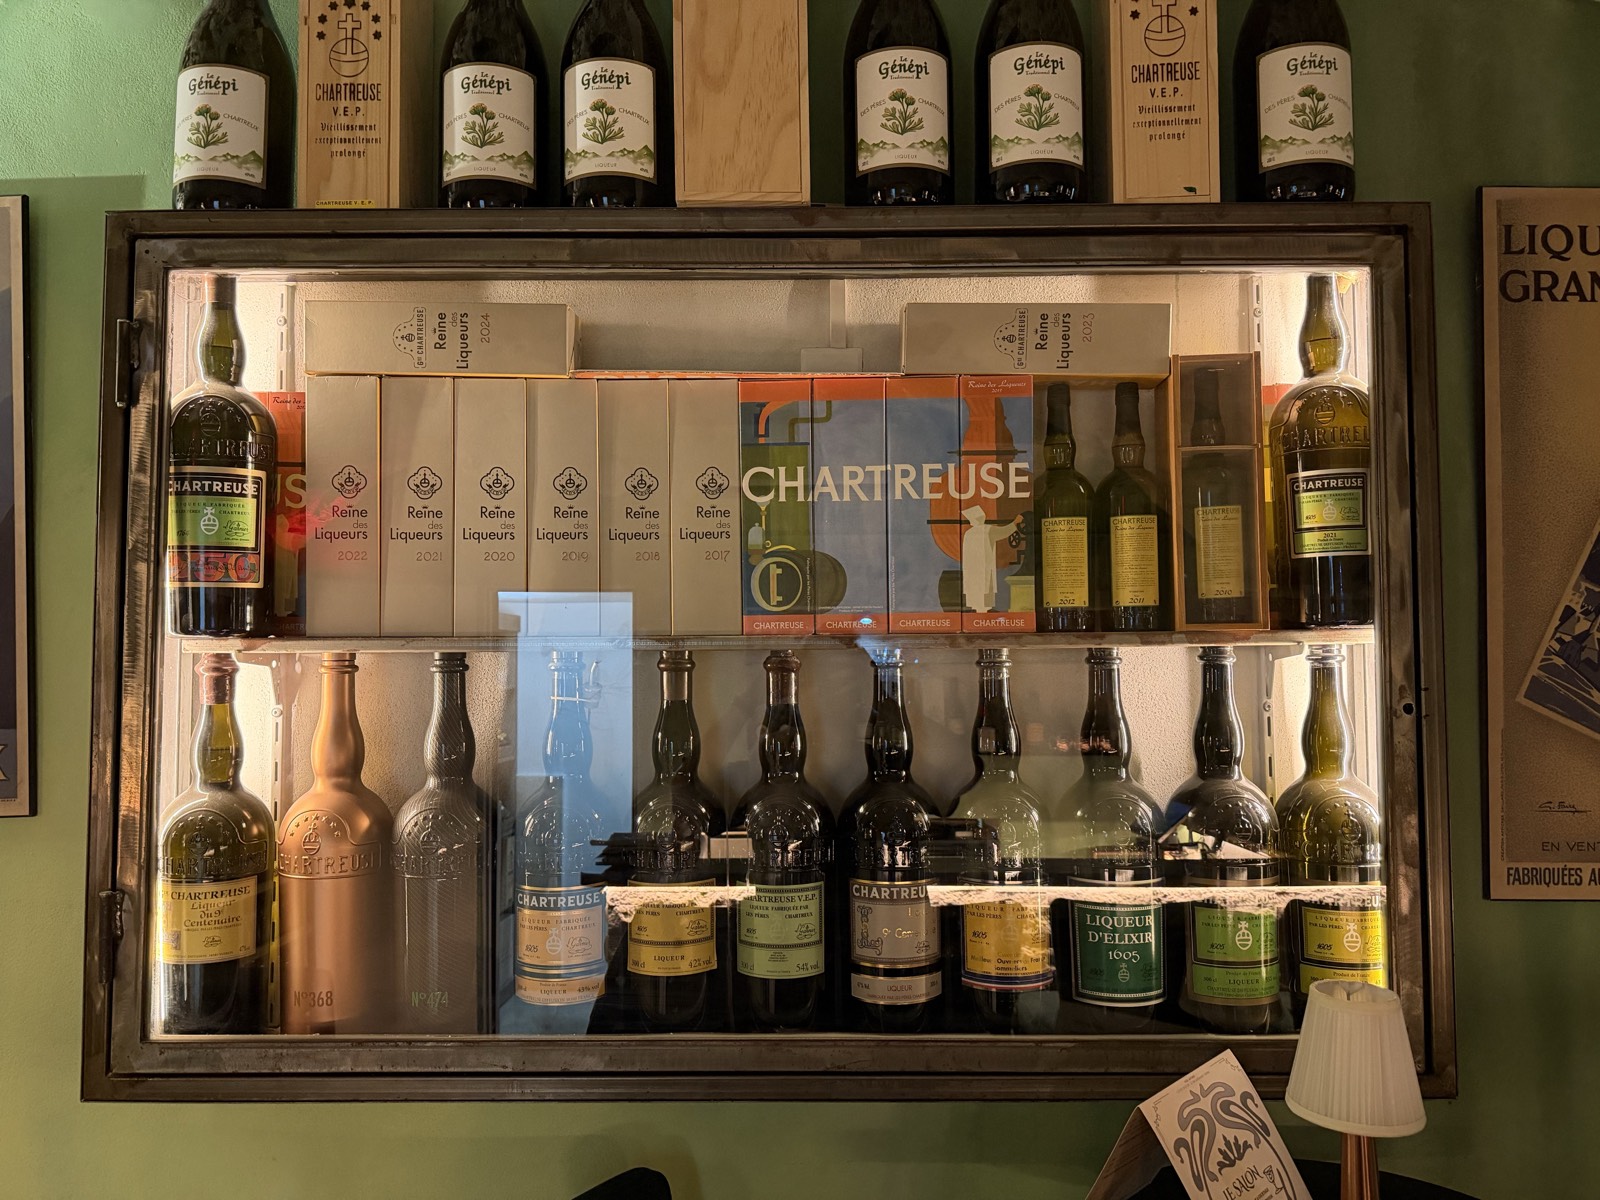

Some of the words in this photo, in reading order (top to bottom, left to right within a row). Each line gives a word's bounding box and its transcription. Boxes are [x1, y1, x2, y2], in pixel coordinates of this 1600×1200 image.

[879, 59, 929, 79] Génépi
[1014, 55, 1065, 75] Génépi
[1287, 55, 1338, 75] Génépi
[1131, 62, 1200, 83] CHARTREUSE
[188, 76, 238, 95] Génépi
[461, 75, 512, 95] Génépi
[582, 70, 631, 90] Génépi
[316, 83, 382, 102] CHARTREUSE
[861, 107, 869, 117] DES
[918, 98, 945, 116] CHARTREUX
[994, 104, 1004, 113] DES
[1138, 104, 1195, 114] Vieillissement
[1265, 104, 1275, 113] DES
[499, 113, 530, 132] CHARTREUX
[619, 108, 650, 125] CHARTREUX
[321, 123, 376, 131] Vieillissement
[1149, 130, 1185, 142] prolongé
[330, 149, 366, 158] prolongé
[449, 312, 457, 327] des
[1050, 313, 1059, 327] des
[434, 312, 446, 349] Reine
[480, 313, 490, 343] 2024
[1035, 313, 1048, 349] Reine
[1083, 313, 1094, 342] 2023
[456, 313, 472, 368] Liqueurs
[1056, 313, 1073, 368] Liqueurs
[742, 462, 1030, 502] CHARTREUSE
[1294, 478, 1363, 491] CHARTREUSE
[332, 505, 367, 518] Reine
[408, 506, 443, 518] Reine
[480, 506, 515, 518] Reine
[554, 506, 588, 518] Reine
[626, 507, 659, 519] Reine
[696, 506, 730, 518] Reine
[353, 520, 367, 528] des
[428, 521, 443, 529] des
[500, 521, 515, 529] des
[574, 521, 588, 529] des
[645, 521, 659, 529] des
[716, 520, 730, 528] des
[315, 528, 367, 543] Liqueurs
[390, 528, 442, 543] Liqueurs
[463, 528, 515, 543] Liqueurs
[536, 528, 588, 543] Liqueurs
[609, 528, 659, 544] Liqueurs
[680, 528, 730, 543] Liqueurs
[337, 551, 367, 560] 2022
[416, 552, 442, 561] 2021
[484, 552, 515, 561] 2020
[562, 552, 588, 561] 2019
[635, 552, 660, 560] 2018
[705, 551, 730, 562] 2017
[1542, 842, 1559, 851] EN
[1506, 864, 1582, 887] FABRIQUÉES
[171, 886, 250, 900] CHARTREUSE
[852, 885, 927, 899] CHARTREU
[191, 900, 235, 910] Liqueur
[518, 892, 600, 908] CHARTREUSE
[184, 915, 241, 927] Centenaire
[200, 910, 212, 919] du
[1086, 914, 1153, 929] LIQUEUR
[1088, 931, 1153, 944] D'ELIXIR
[1108, 949, 1140, 963] 1605
